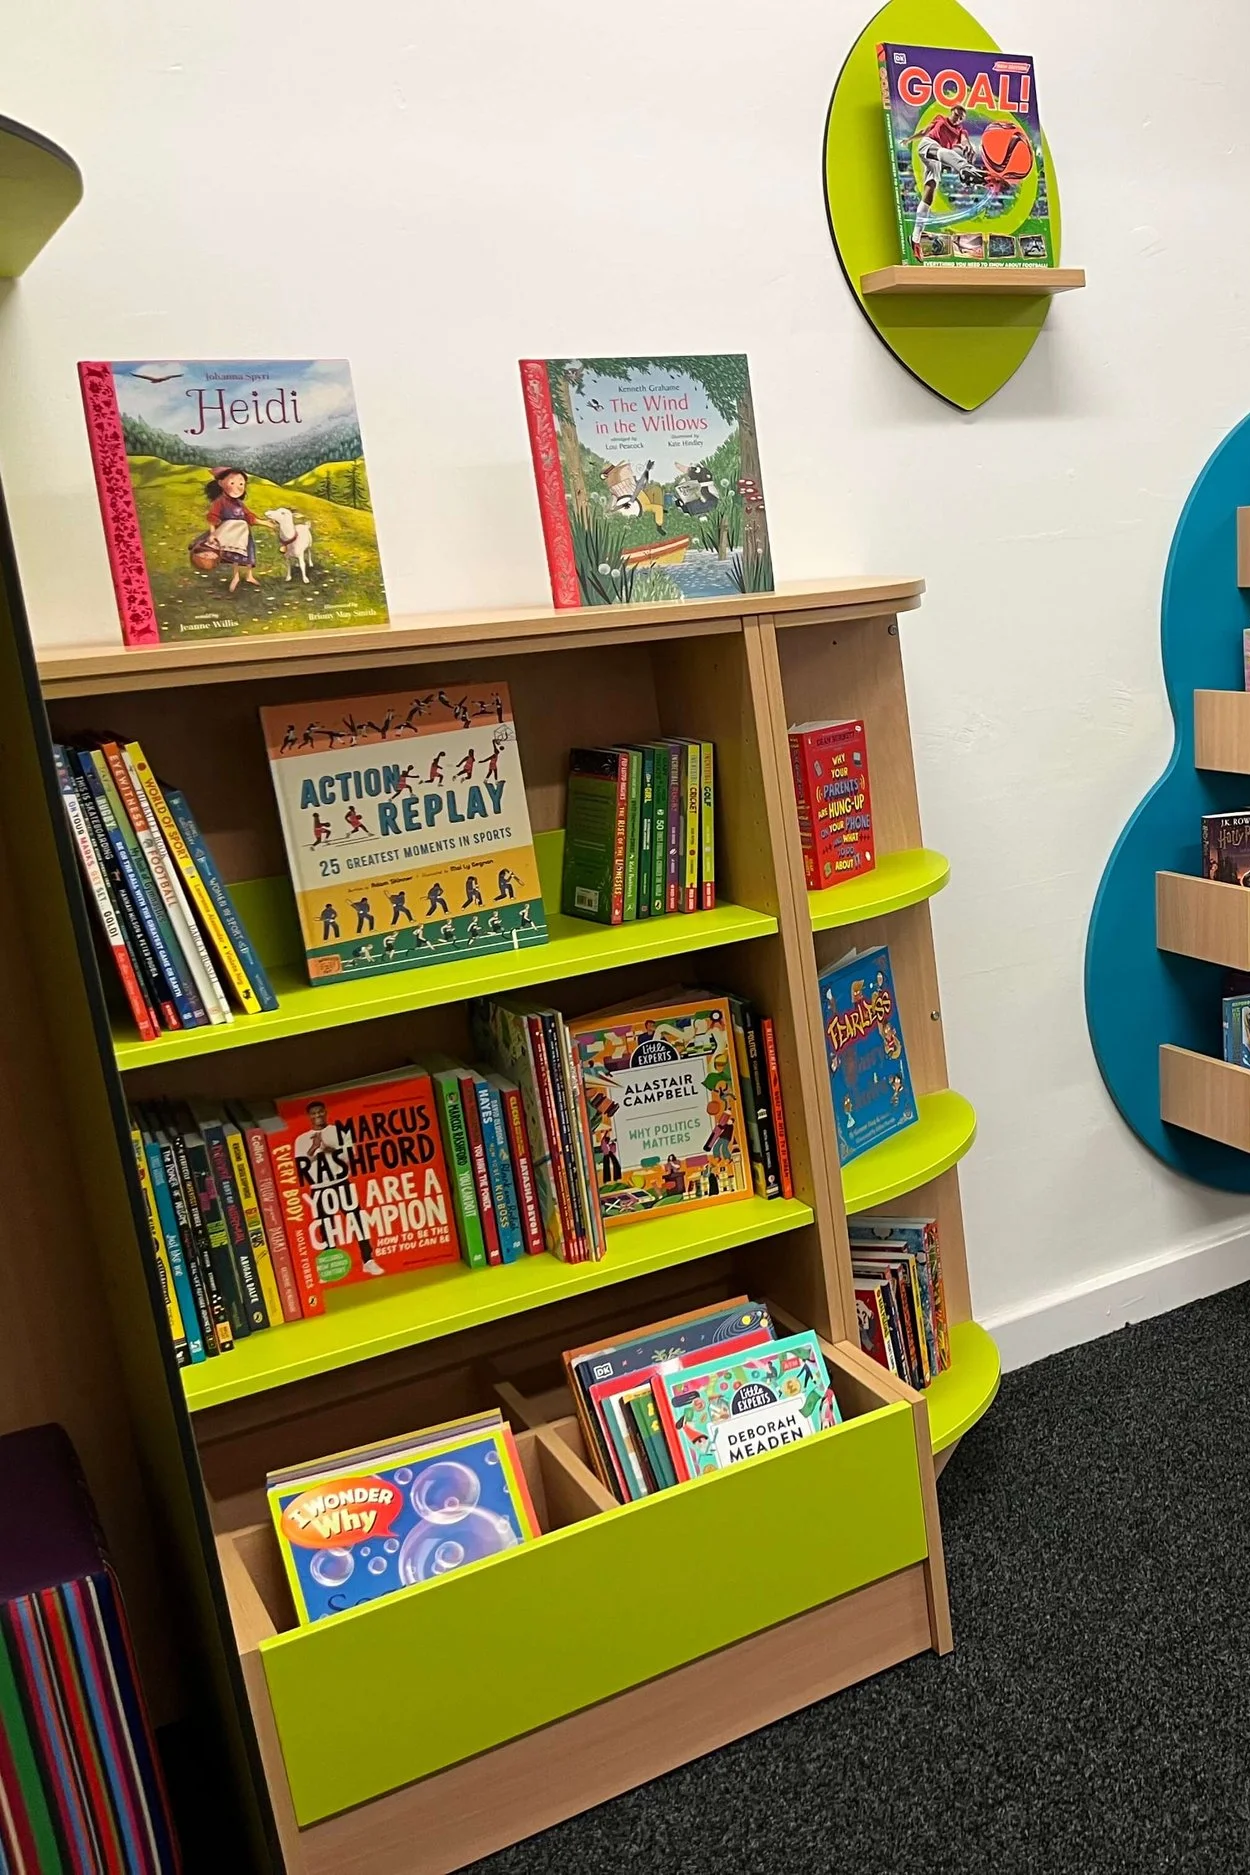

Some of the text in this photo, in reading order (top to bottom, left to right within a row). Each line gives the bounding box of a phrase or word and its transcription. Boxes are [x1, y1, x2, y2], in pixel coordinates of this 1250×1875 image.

[897, 66, 1030, 113] GOAL!
[618, 384, 680, 393] Kenneth Grahame
[184, 388, 302, 435] Heidi
[609, 393, 689, 412] The Wind
[595, 414, 708, 434] in the Willows
[180, 619, 239, 632] Jeanne Willis
[831, 753, 846, 766] WHY
[830, 767, 848, 779] YOUR
[300, 764, 400, 809] ACTION
[823, 778, 859, 798] PARENTS
[75, 775, 113, 860] THIS IS SKATEBOARDING
[96, 797, 116, 828] RUGBY
[378, 780, 506, 836] REPLAY
[817, 794, 865, 820] ARE HUNG-UP
[108, 753, 177, 907] EYEWITNESS FOOTBALL
[143, 777, 188, 861] WORLD OF SPORT
[617, 819, 625, 835] RISE
[656, 819, 663, 830] 50
[829, 815, 870, 835] YOUR PHONE
[68, 801, 101, 885] ON YOUR GET
[842, 834, 859, 845] WHAT
[1218, 828, 1244, 849] Harry
[319, 827, 512, 877] 25 GREATEST MOMENTS IN SPORTS
[835, 858, 853, 871] ABOUT
[135, 889, 146, 906] WITH
[208, 877, 228, 907] WOMEN
[225, 915, 244, 941] SPORT
[827, 990, 892, 1050] FEARLESS
[642, 1043, 667, 1055] Little
[746, 1029, 757, 1058] POLITICS
[638, 1050, 672, 1065] EXPERTS
[624, 1073, 693, 1096] ALASTAIR
[623, 1085, 699, 1108] CAMPBELL
[448, 1103, 461, 1131] MARCUS
[489, 1099, 499, 1118] DAVID
[335, 1104, 431, 1146] MARCUS
[629, 1117, 701, 1140] WHY POLITICS
[249, 1134, 266, 1164] Collins
[452, 1131, 466, 1166] RASHFORD
[473, 1143, 483, 1157] YOU
[642, 1132, 691, 1150] MATTERS
[161, 1150, 172, 1163] The
[295, 1133, 435, 1187] RASHFORD
[475, 1157, 487, 1173] HAVE
[478, 1088, 510, 1228] HAYES KID BOSS
[508, 1095, 538, 1235] CLICKS NATASHA DEVON
[164, 1162, 179, 1188] POWER
[458, 1170, 471, 1187] YOU
[477, 1174, 488, 1187] THE
[301, 1168, 443, 1219] YOU ARE A
[459, 1185, 474, 1201] CAN
[270, 1143, 315, 1289] EVERY BODY MOLLY FORBES
[308, 1194, 448, 1251] CHAMPION
[206, 1219, 227, 1247] GO BIG
[249, 1227, 265, 1248] NEWS
[377, 1226, 450, 1247] HOW TO BE THE
[164, 1232, 182, 1264] Just like
[375, 1234, 450, 1257] BEST YOU CAN BE
[239, 1254, 254, 1282] ABIGAIL
[246, 1282, 259, 1303] BALFE
[595, 1365, 611, 1377] DK
[783, 1359, 799, 1370] ATM
[737, 1393, 771, 1412] EXPERTS
[739, 1386, 763, 1400] Little
[728, 1414, 797, 1446] DEBORAH
[729, 1427, 804, 1463] MEADEN
[288, 1487, 394, 1529] I WONDER
[314, 1509, 377, 1540] Why
